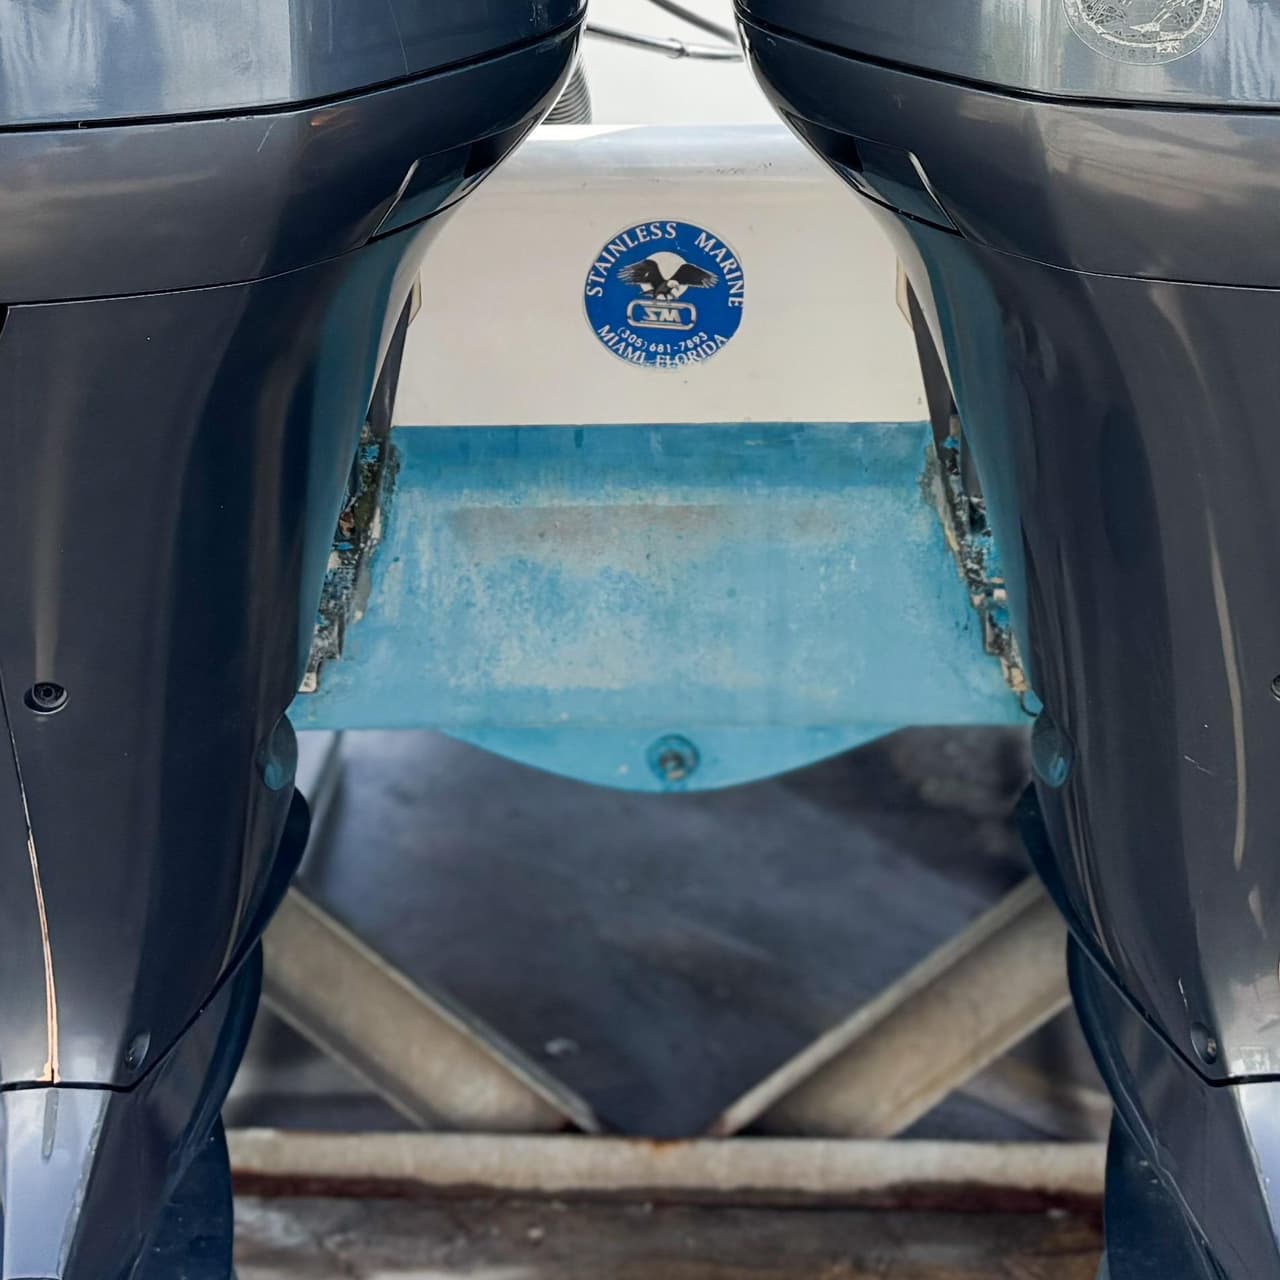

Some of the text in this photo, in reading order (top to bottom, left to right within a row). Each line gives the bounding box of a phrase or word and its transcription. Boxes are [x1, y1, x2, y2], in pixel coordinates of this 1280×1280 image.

[586, 222, 745, 308] STAINLESS MARINE
[617, 326, 708, 353] (305) 681-7893
[656, 333, 729, 368] FLORIDA
